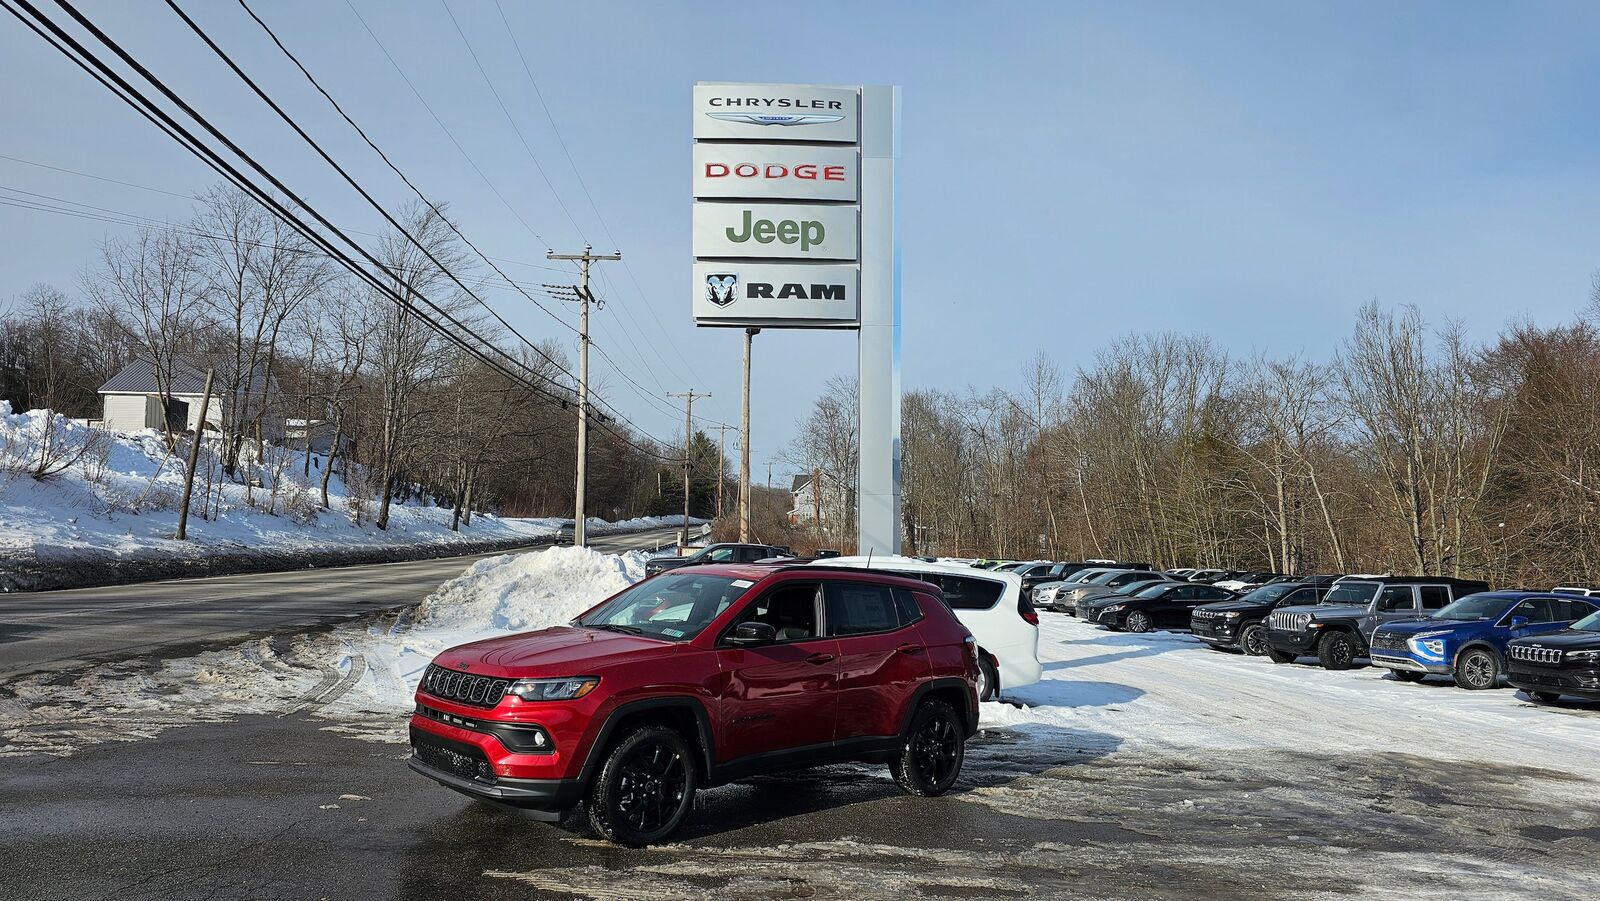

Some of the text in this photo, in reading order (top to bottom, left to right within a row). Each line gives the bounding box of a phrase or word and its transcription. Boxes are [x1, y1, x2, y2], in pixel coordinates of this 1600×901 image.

[709, 98, 842, 109] CHRYSLER
[705, 163, 845, 181] DODGE
[725, 210, 825, 251] Jeep
[746, 282, 845, 300] RAM
